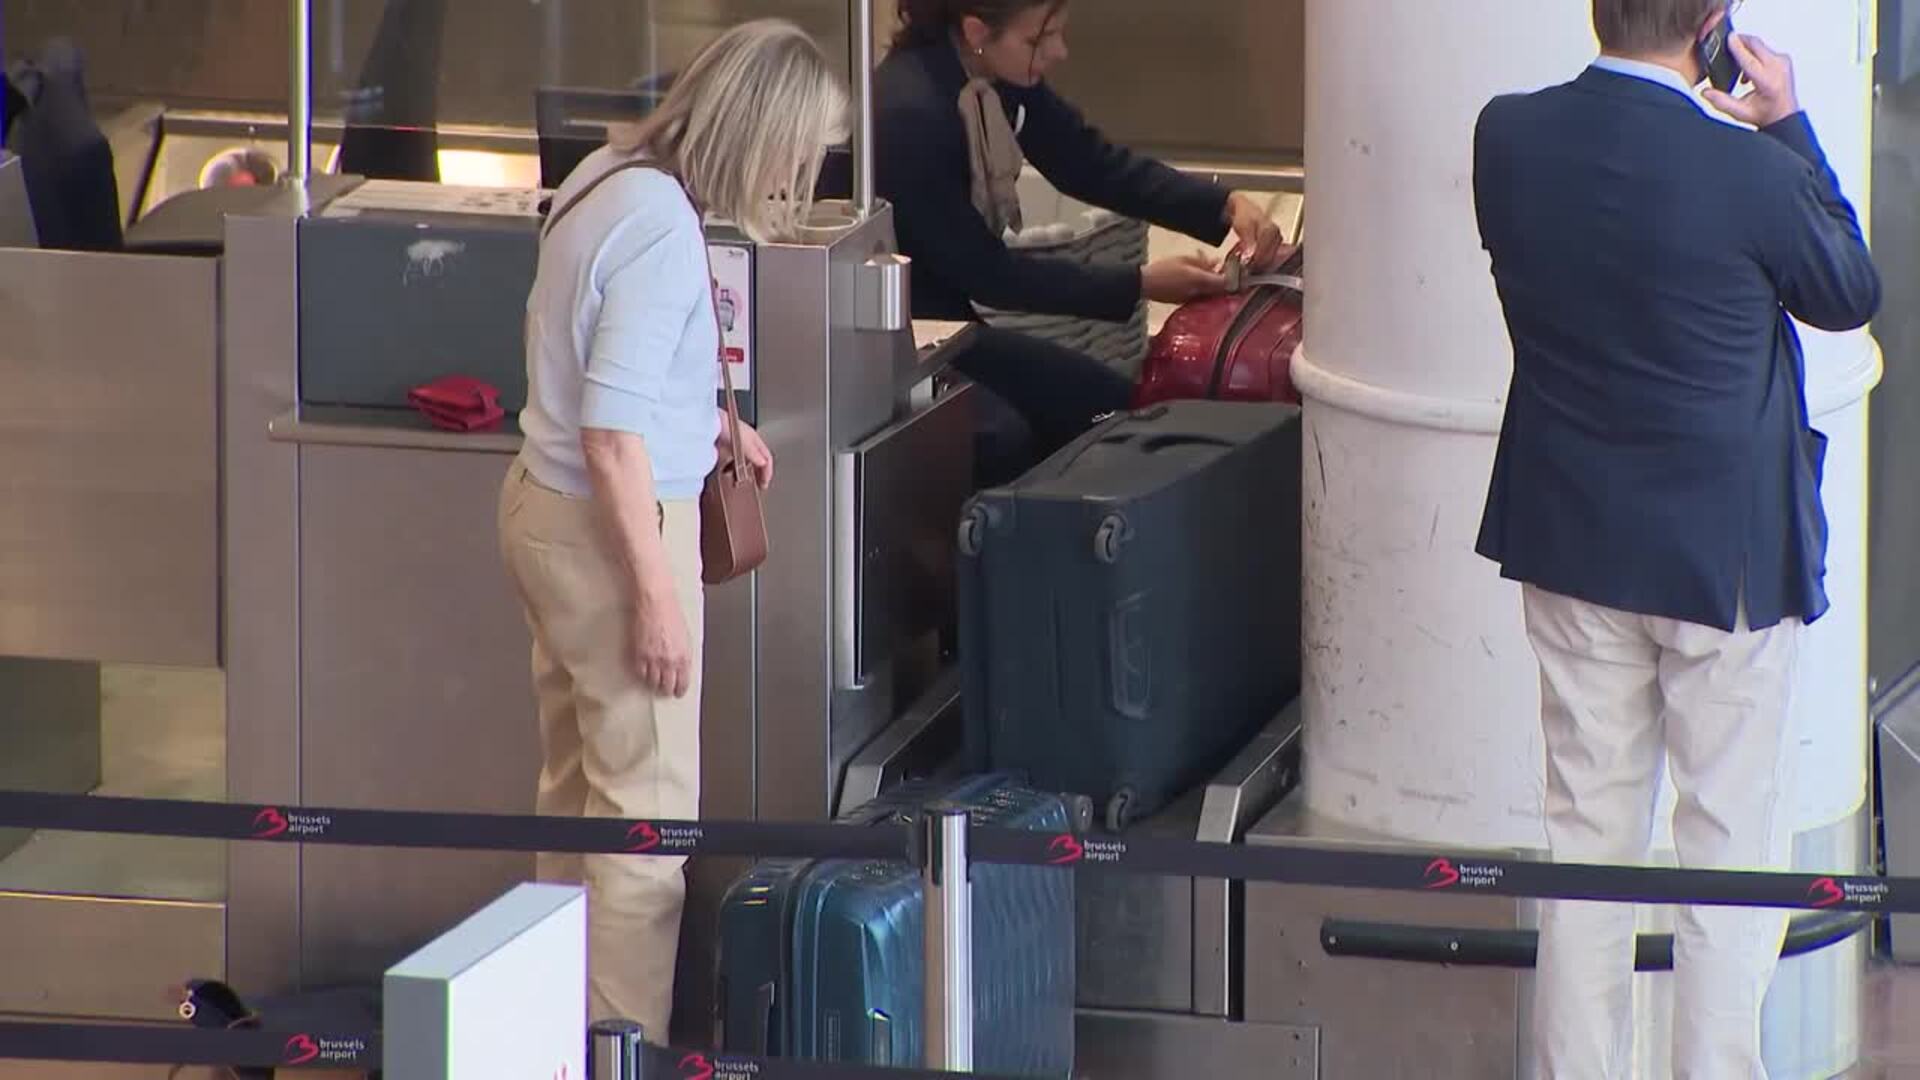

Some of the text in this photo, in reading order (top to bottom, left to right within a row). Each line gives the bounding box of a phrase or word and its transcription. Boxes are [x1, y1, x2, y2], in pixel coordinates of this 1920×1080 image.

[288, 814, 331, 824] brussels
[289, 823, 324, 834] airport
[660, 827, 703, 838] brussels
[661, 836, 696, 847] airport
[1084, 840, 1126, 852] brussels
[1084, 850, 1119, 861] airport
[1460, 864, 1503, 876] brussels
[1460, 874, 1496, 886] airport
[1844, 883, 1889, 893] brussels
[1844, 892, 1882, 903] airport
[320, 1038, 365, 1049] brussels
[320, 1048, 356, 1060] airport
[714, 1059, 759, 1072] brussels
